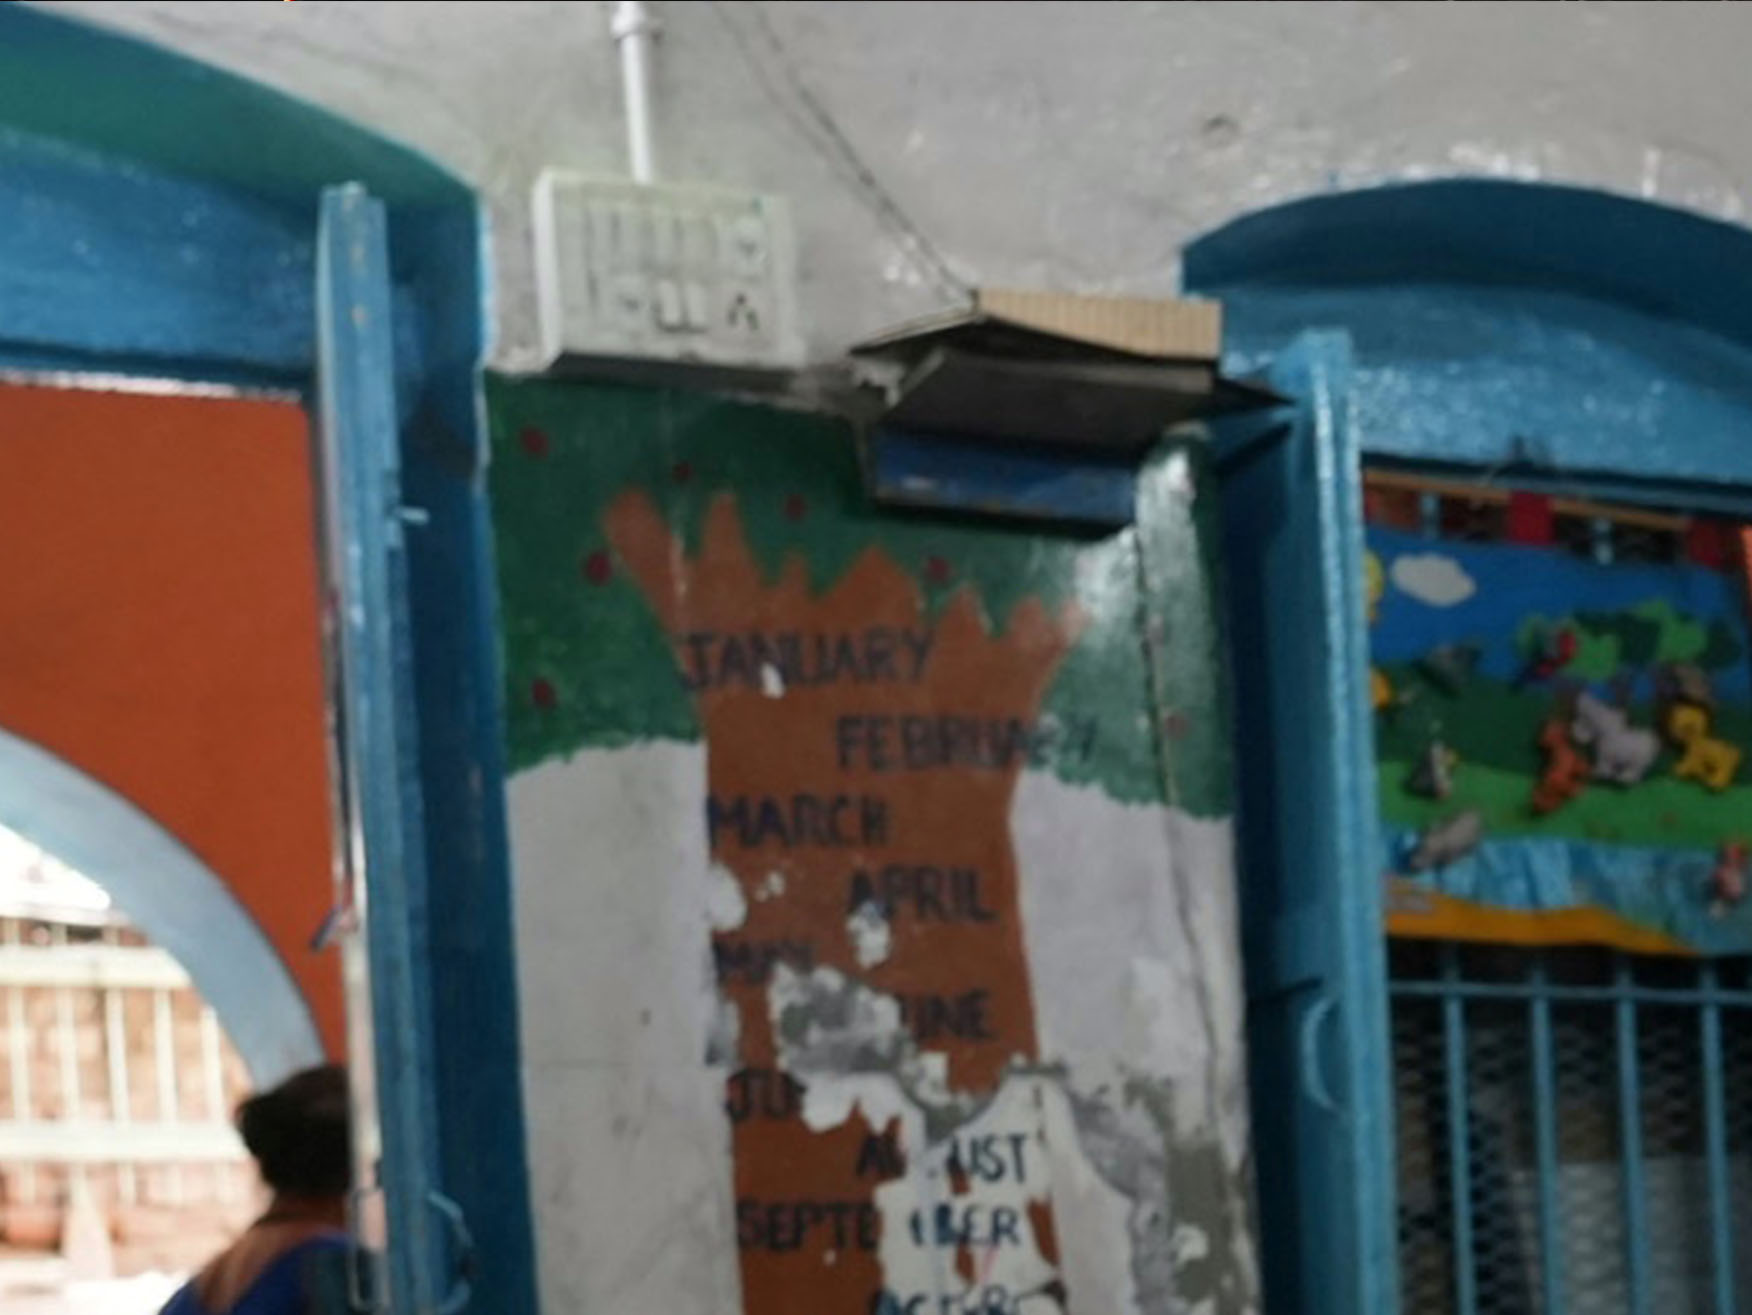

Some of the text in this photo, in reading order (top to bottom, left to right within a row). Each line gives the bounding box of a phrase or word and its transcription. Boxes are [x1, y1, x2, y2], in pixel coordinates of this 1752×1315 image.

[681, 628, 936, 689] JANUARY
[704, 793, 889, 848] MARCH
[847, 865, 998, 922] APRIL
[895, 985, 997, 1040] UNE
